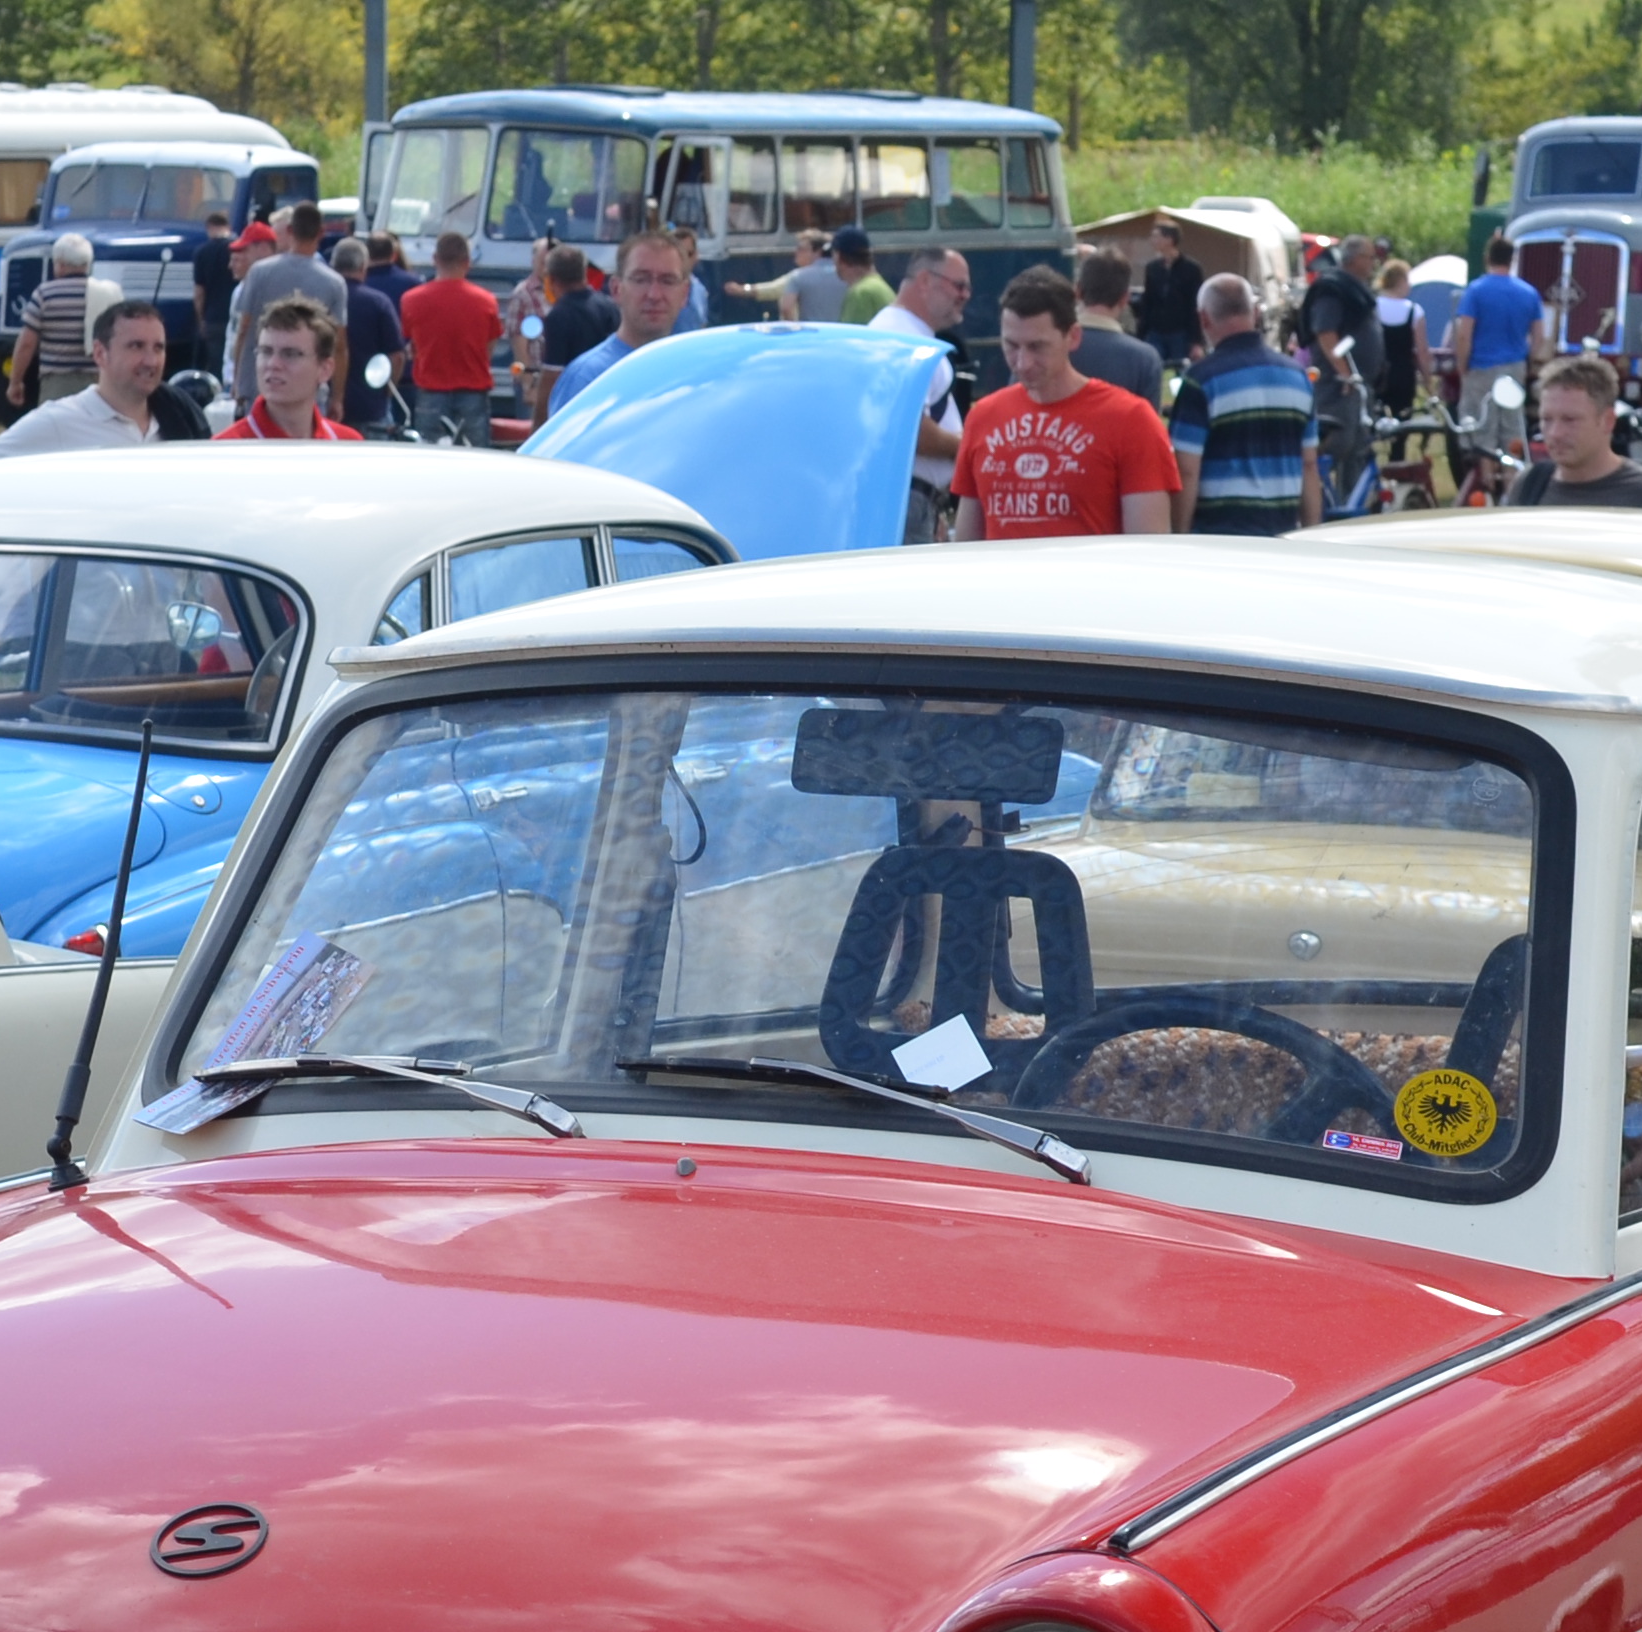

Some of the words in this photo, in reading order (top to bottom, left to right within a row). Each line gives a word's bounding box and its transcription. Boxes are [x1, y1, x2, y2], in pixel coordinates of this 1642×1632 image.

[985, 412, 1094, 454] MUSTANG
[987, 492, 1038, 516] JEANS
[245, 1005, 258, 1018] in
[256, 946, 305, 1001] Schwerin
[1434, 1074, 1471, 1090] ADAC
[1404, 1123, 1477, 1153] Club-Mitglied
